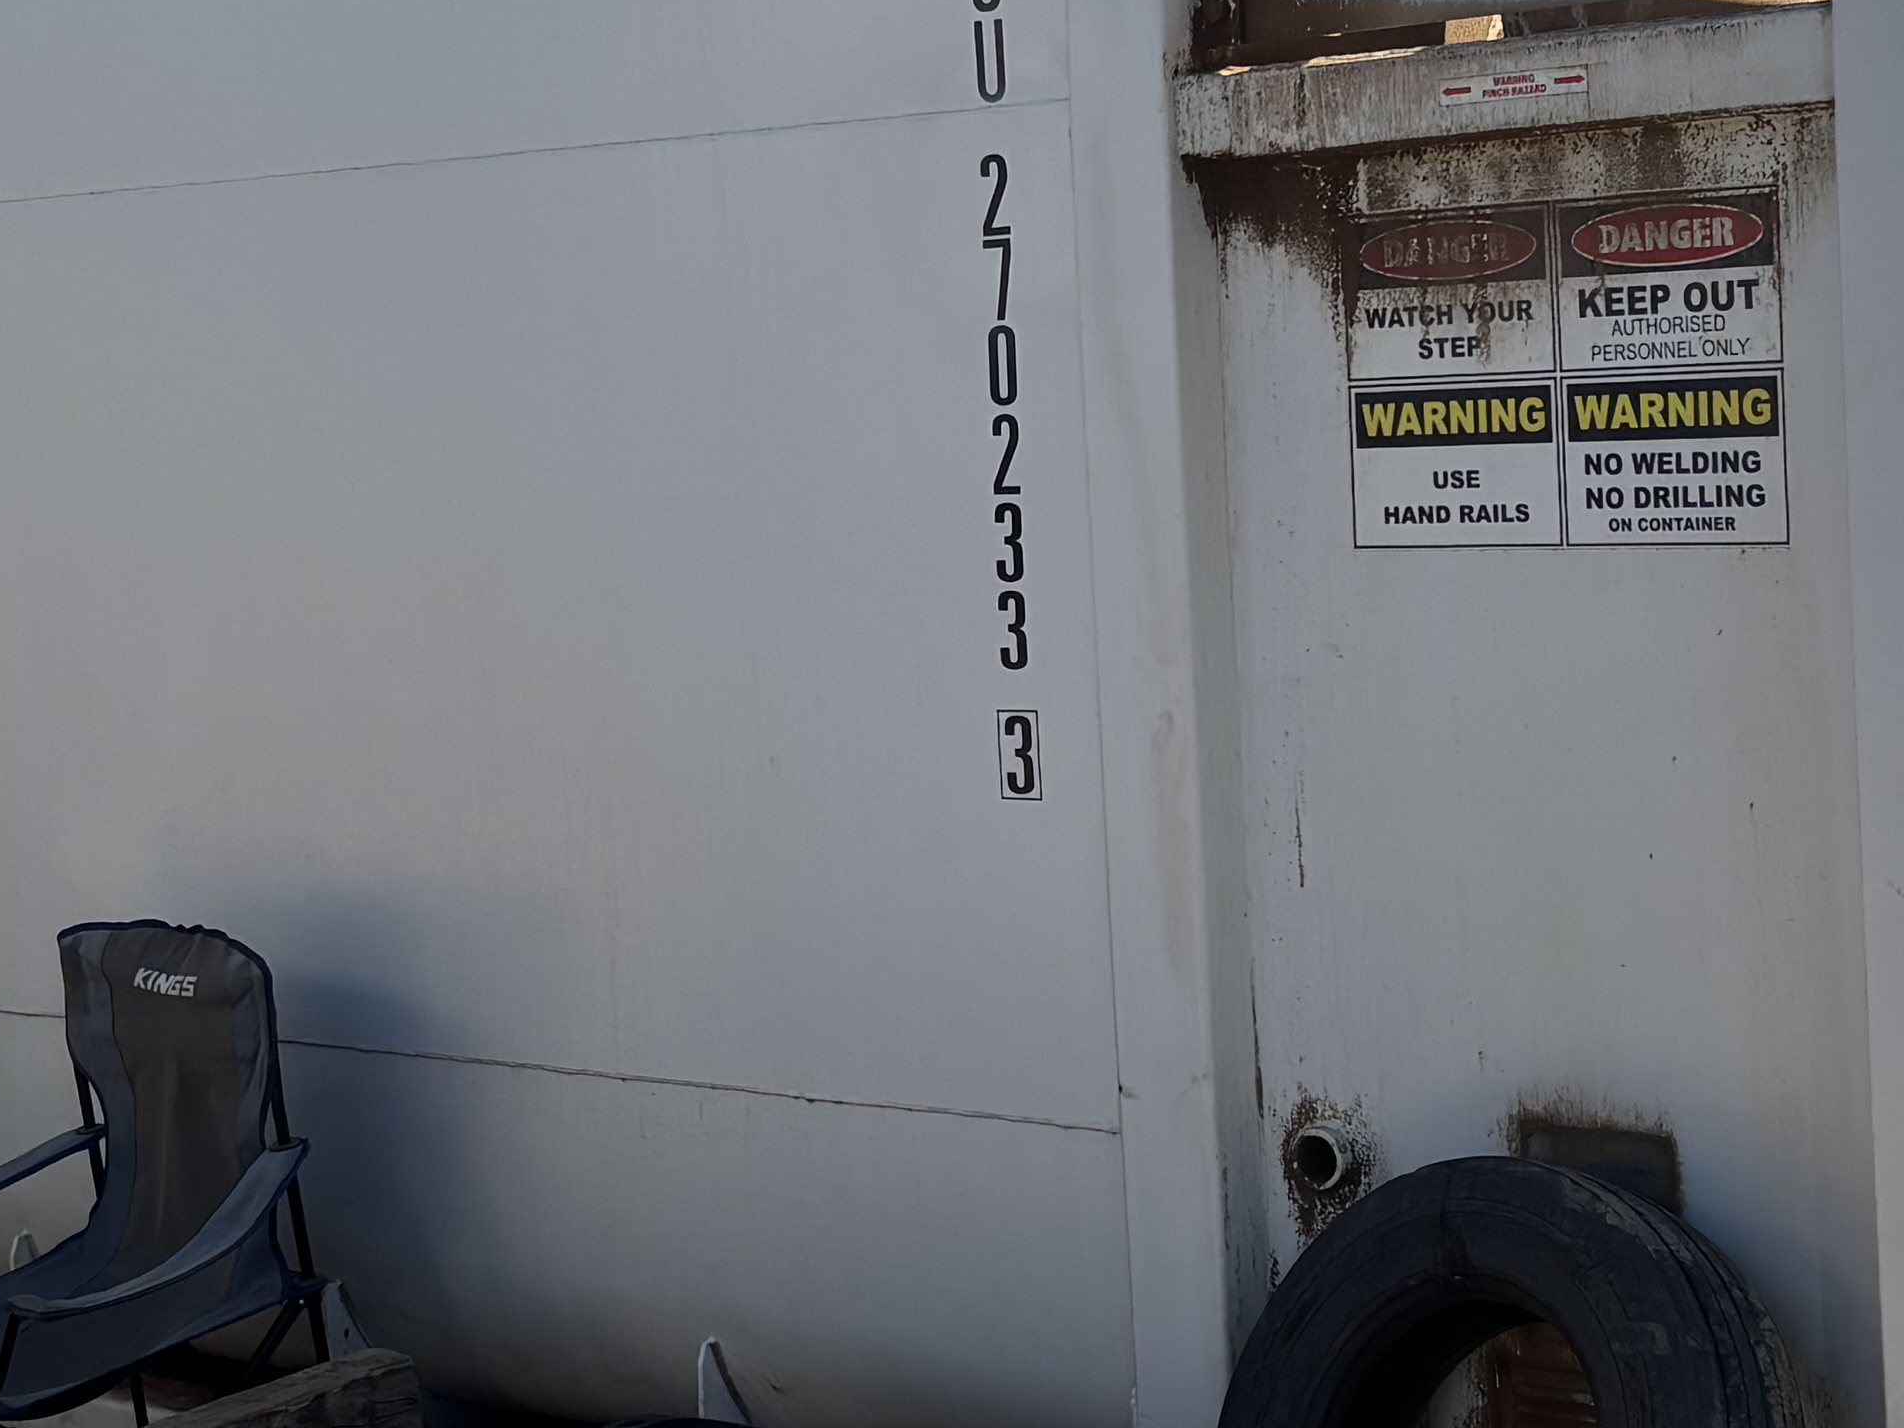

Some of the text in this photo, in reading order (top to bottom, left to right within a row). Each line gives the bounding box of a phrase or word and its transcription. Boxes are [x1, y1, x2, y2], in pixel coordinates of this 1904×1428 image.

[1597, 216, 1735, 255] DANGER
[1578, 279, 1760, 319] KEEP OUT
[1365, 299, 1534, 329] WATCH YOUR
[1611, 314, 1726, 337] AUTHORISED
[1417, 336, 1487, 360] STEP
[1591, 337, 1752, 363] PERSONNEL ONLY
[980, 154, 1027, 670] 270233
[1361, 397, 1546, 437] WARNING
[1574, 389, 1771, 430] WARNING
[1584, 451, 1762, 475] NO WELDING
[1432, 471, 1481, 489] USE
[1585, 484, 1766, 510] NO DRILLING
[1384, 503, 1530, 525] HAND RAILS
[1608, 516, 1736, 533] ON CONTAINER
[1003, 715, 1036, 795] 3
[133, 967, 198, 997] KINGS
